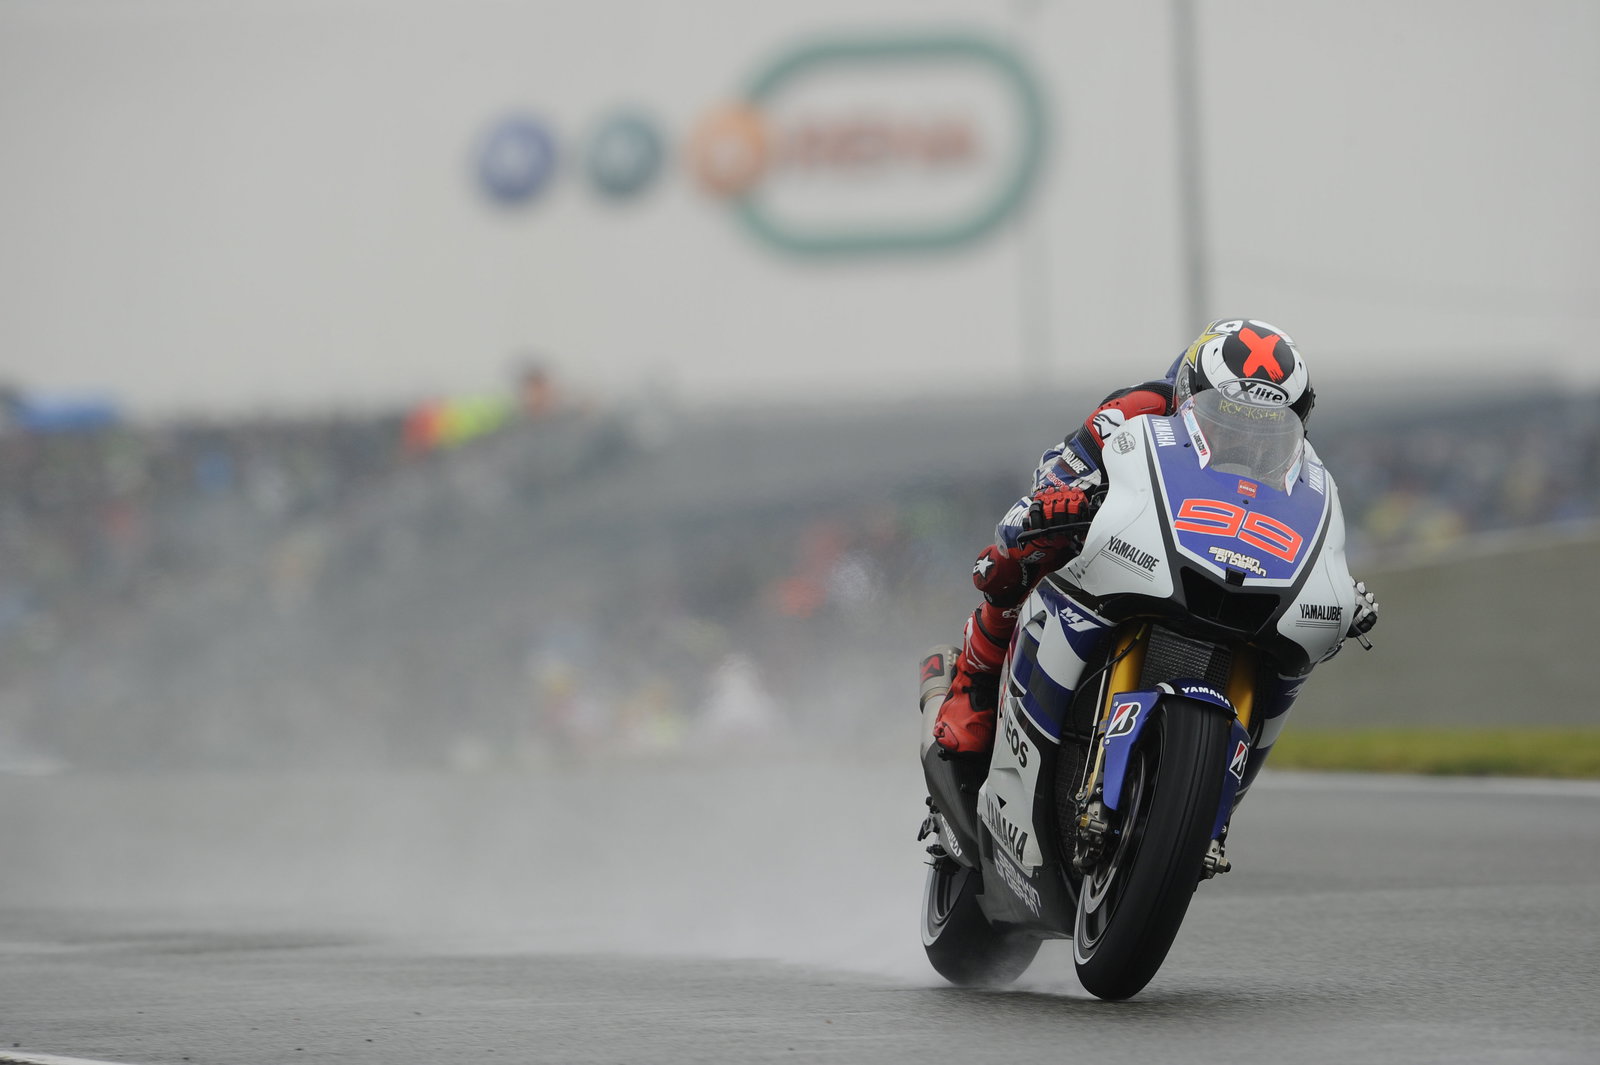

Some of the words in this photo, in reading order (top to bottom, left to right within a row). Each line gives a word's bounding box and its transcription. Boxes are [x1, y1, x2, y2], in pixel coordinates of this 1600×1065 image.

[1151, 418, 1177, 447] YAMAHA
[1174, 498, 1303, 563] 99
[1109, 536, 1160, 572] YAMALUBE
[1208, 546, 1260, 568] SEMAKIN
[1228, 558, 1267, 577] DEPAN
[1299, 603, 1343, 621] YAMALUBE
[1181, 686, 1231, 707] YAMAHA
[985, 793, 1028, 866] YAMAHA
